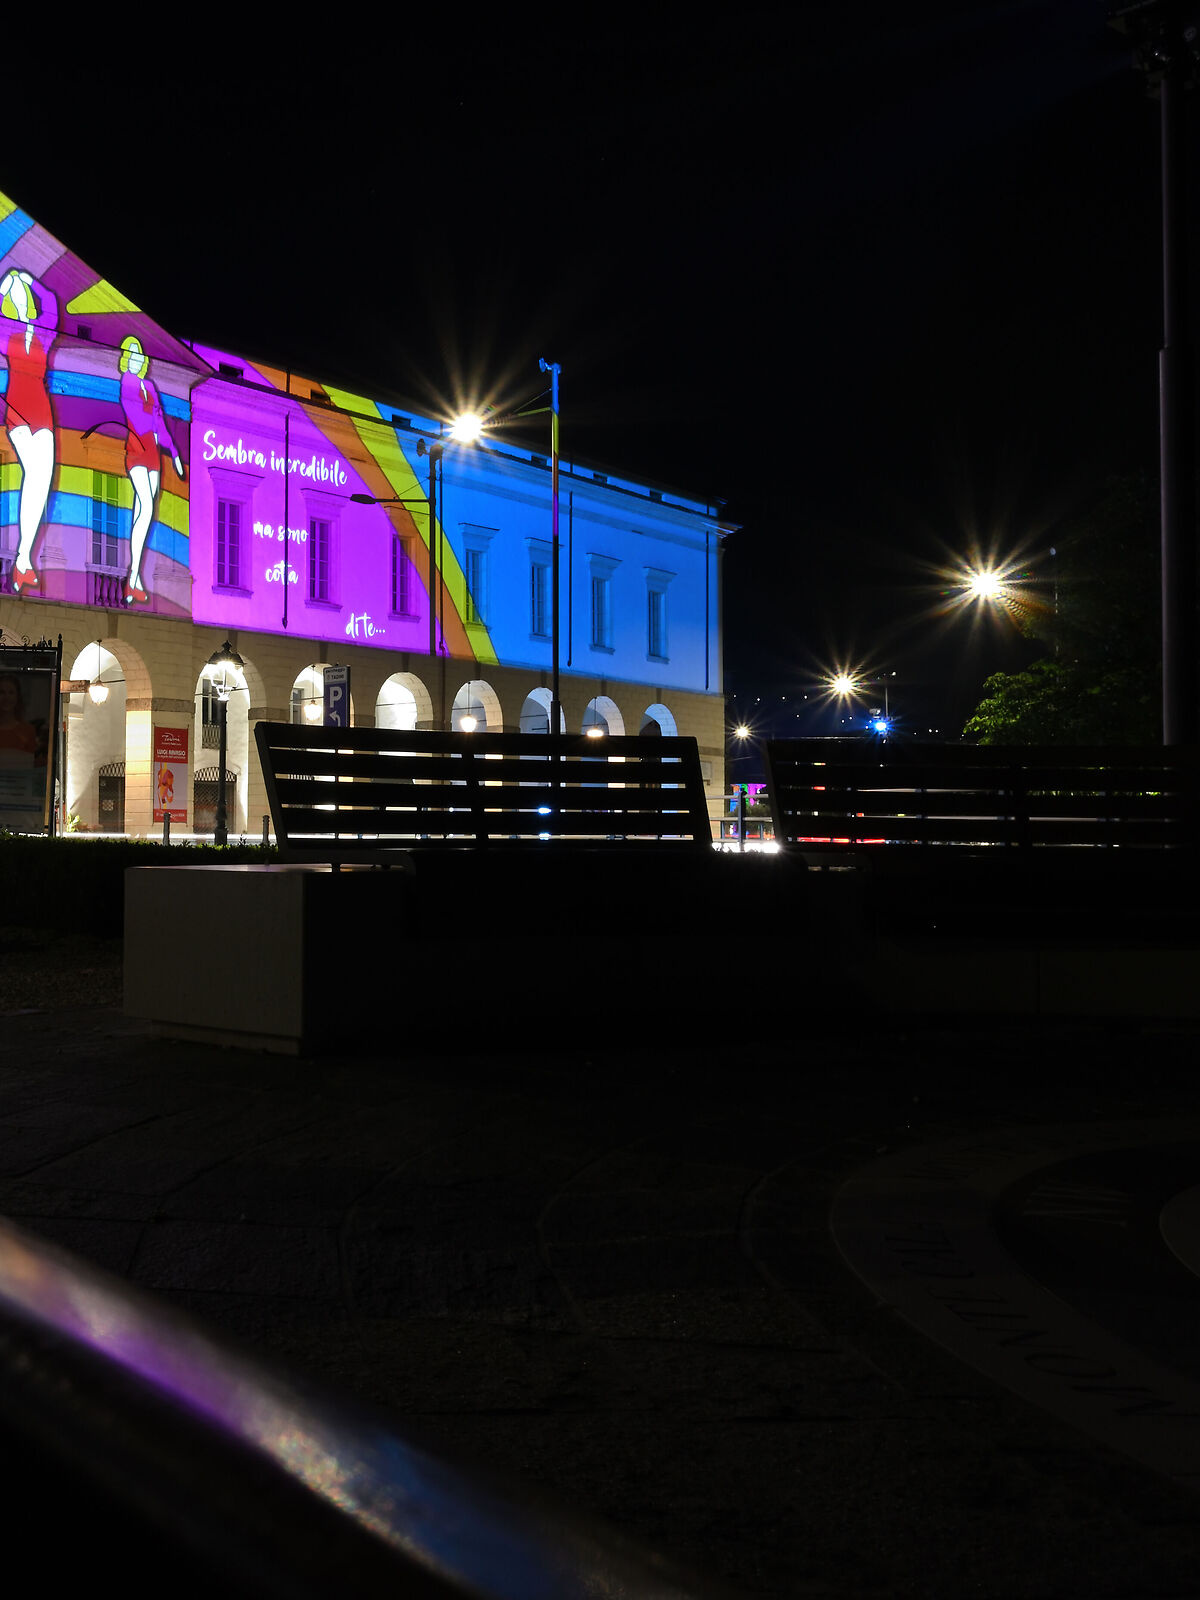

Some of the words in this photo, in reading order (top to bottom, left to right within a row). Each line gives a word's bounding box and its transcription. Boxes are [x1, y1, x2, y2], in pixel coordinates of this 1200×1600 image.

[203, 430, 266, 468] Sembra
[271, 450, 348, 487] incredibile
[253, 521, 274, 538] ma
[277, 525, 309, 544] sono
[329, 686, 342, 708] P
